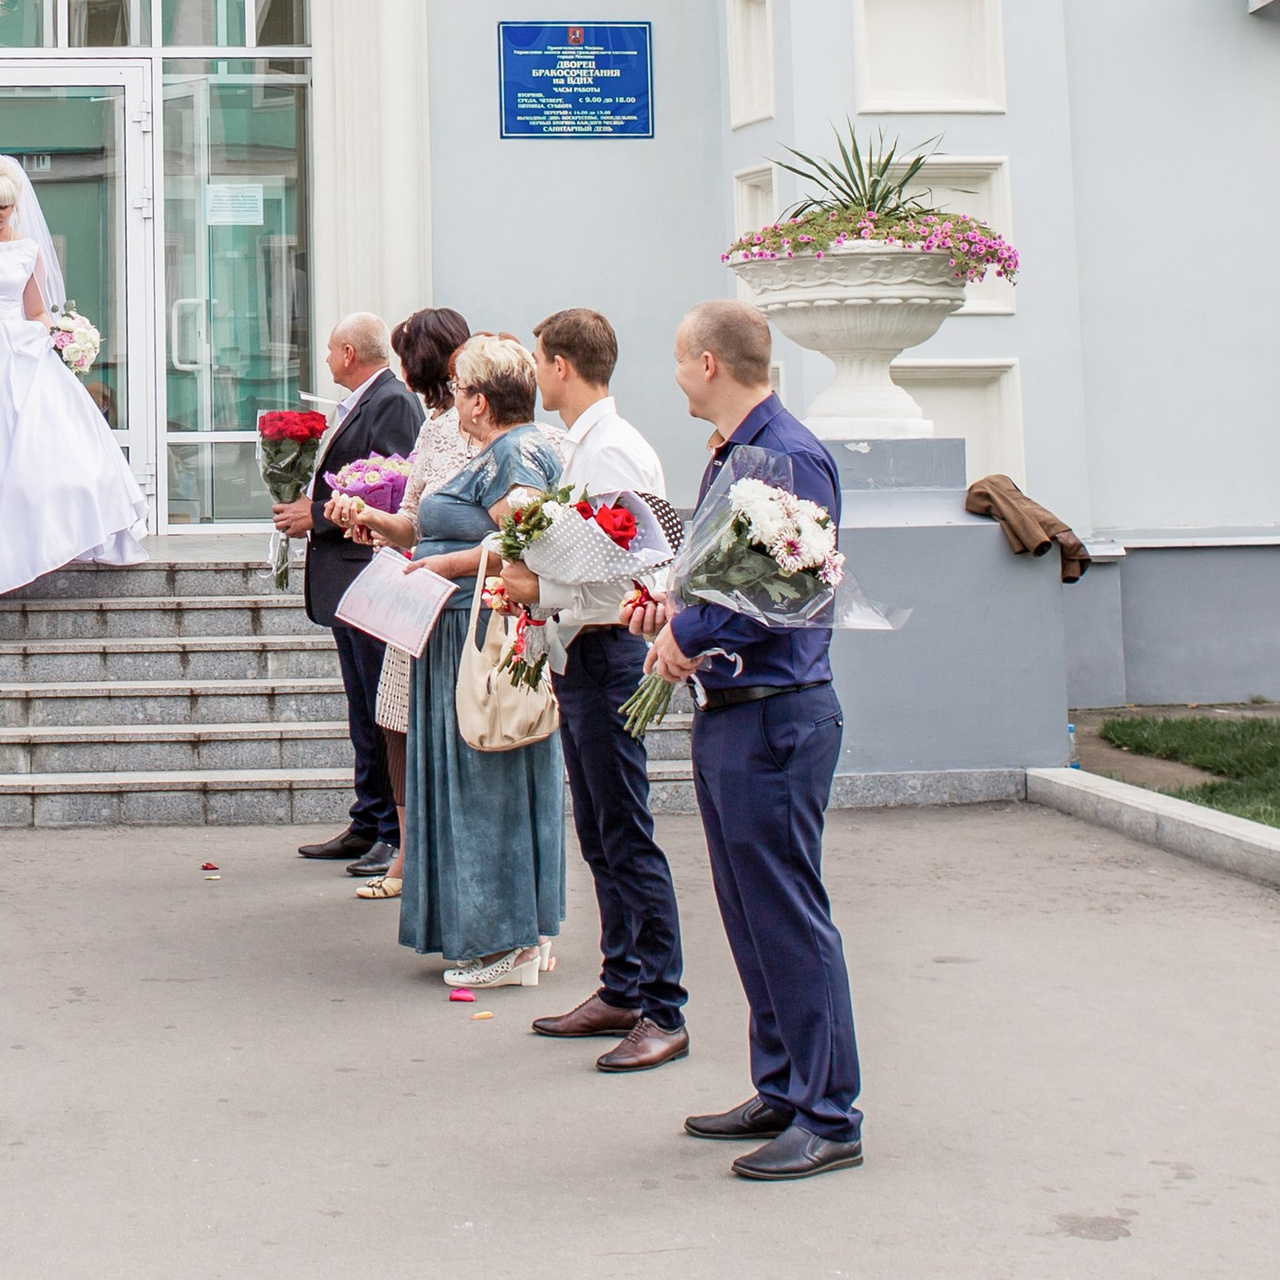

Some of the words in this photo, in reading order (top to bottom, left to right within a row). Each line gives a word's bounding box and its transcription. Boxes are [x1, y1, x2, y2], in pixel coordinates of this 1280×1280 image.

[556, 61, 596, 69] ДВОРЕЦ
[532, 69, 620, 77] БРАКОСОЧЕТАНИЯ
[567, 77, 594, 85] ВДНХ
